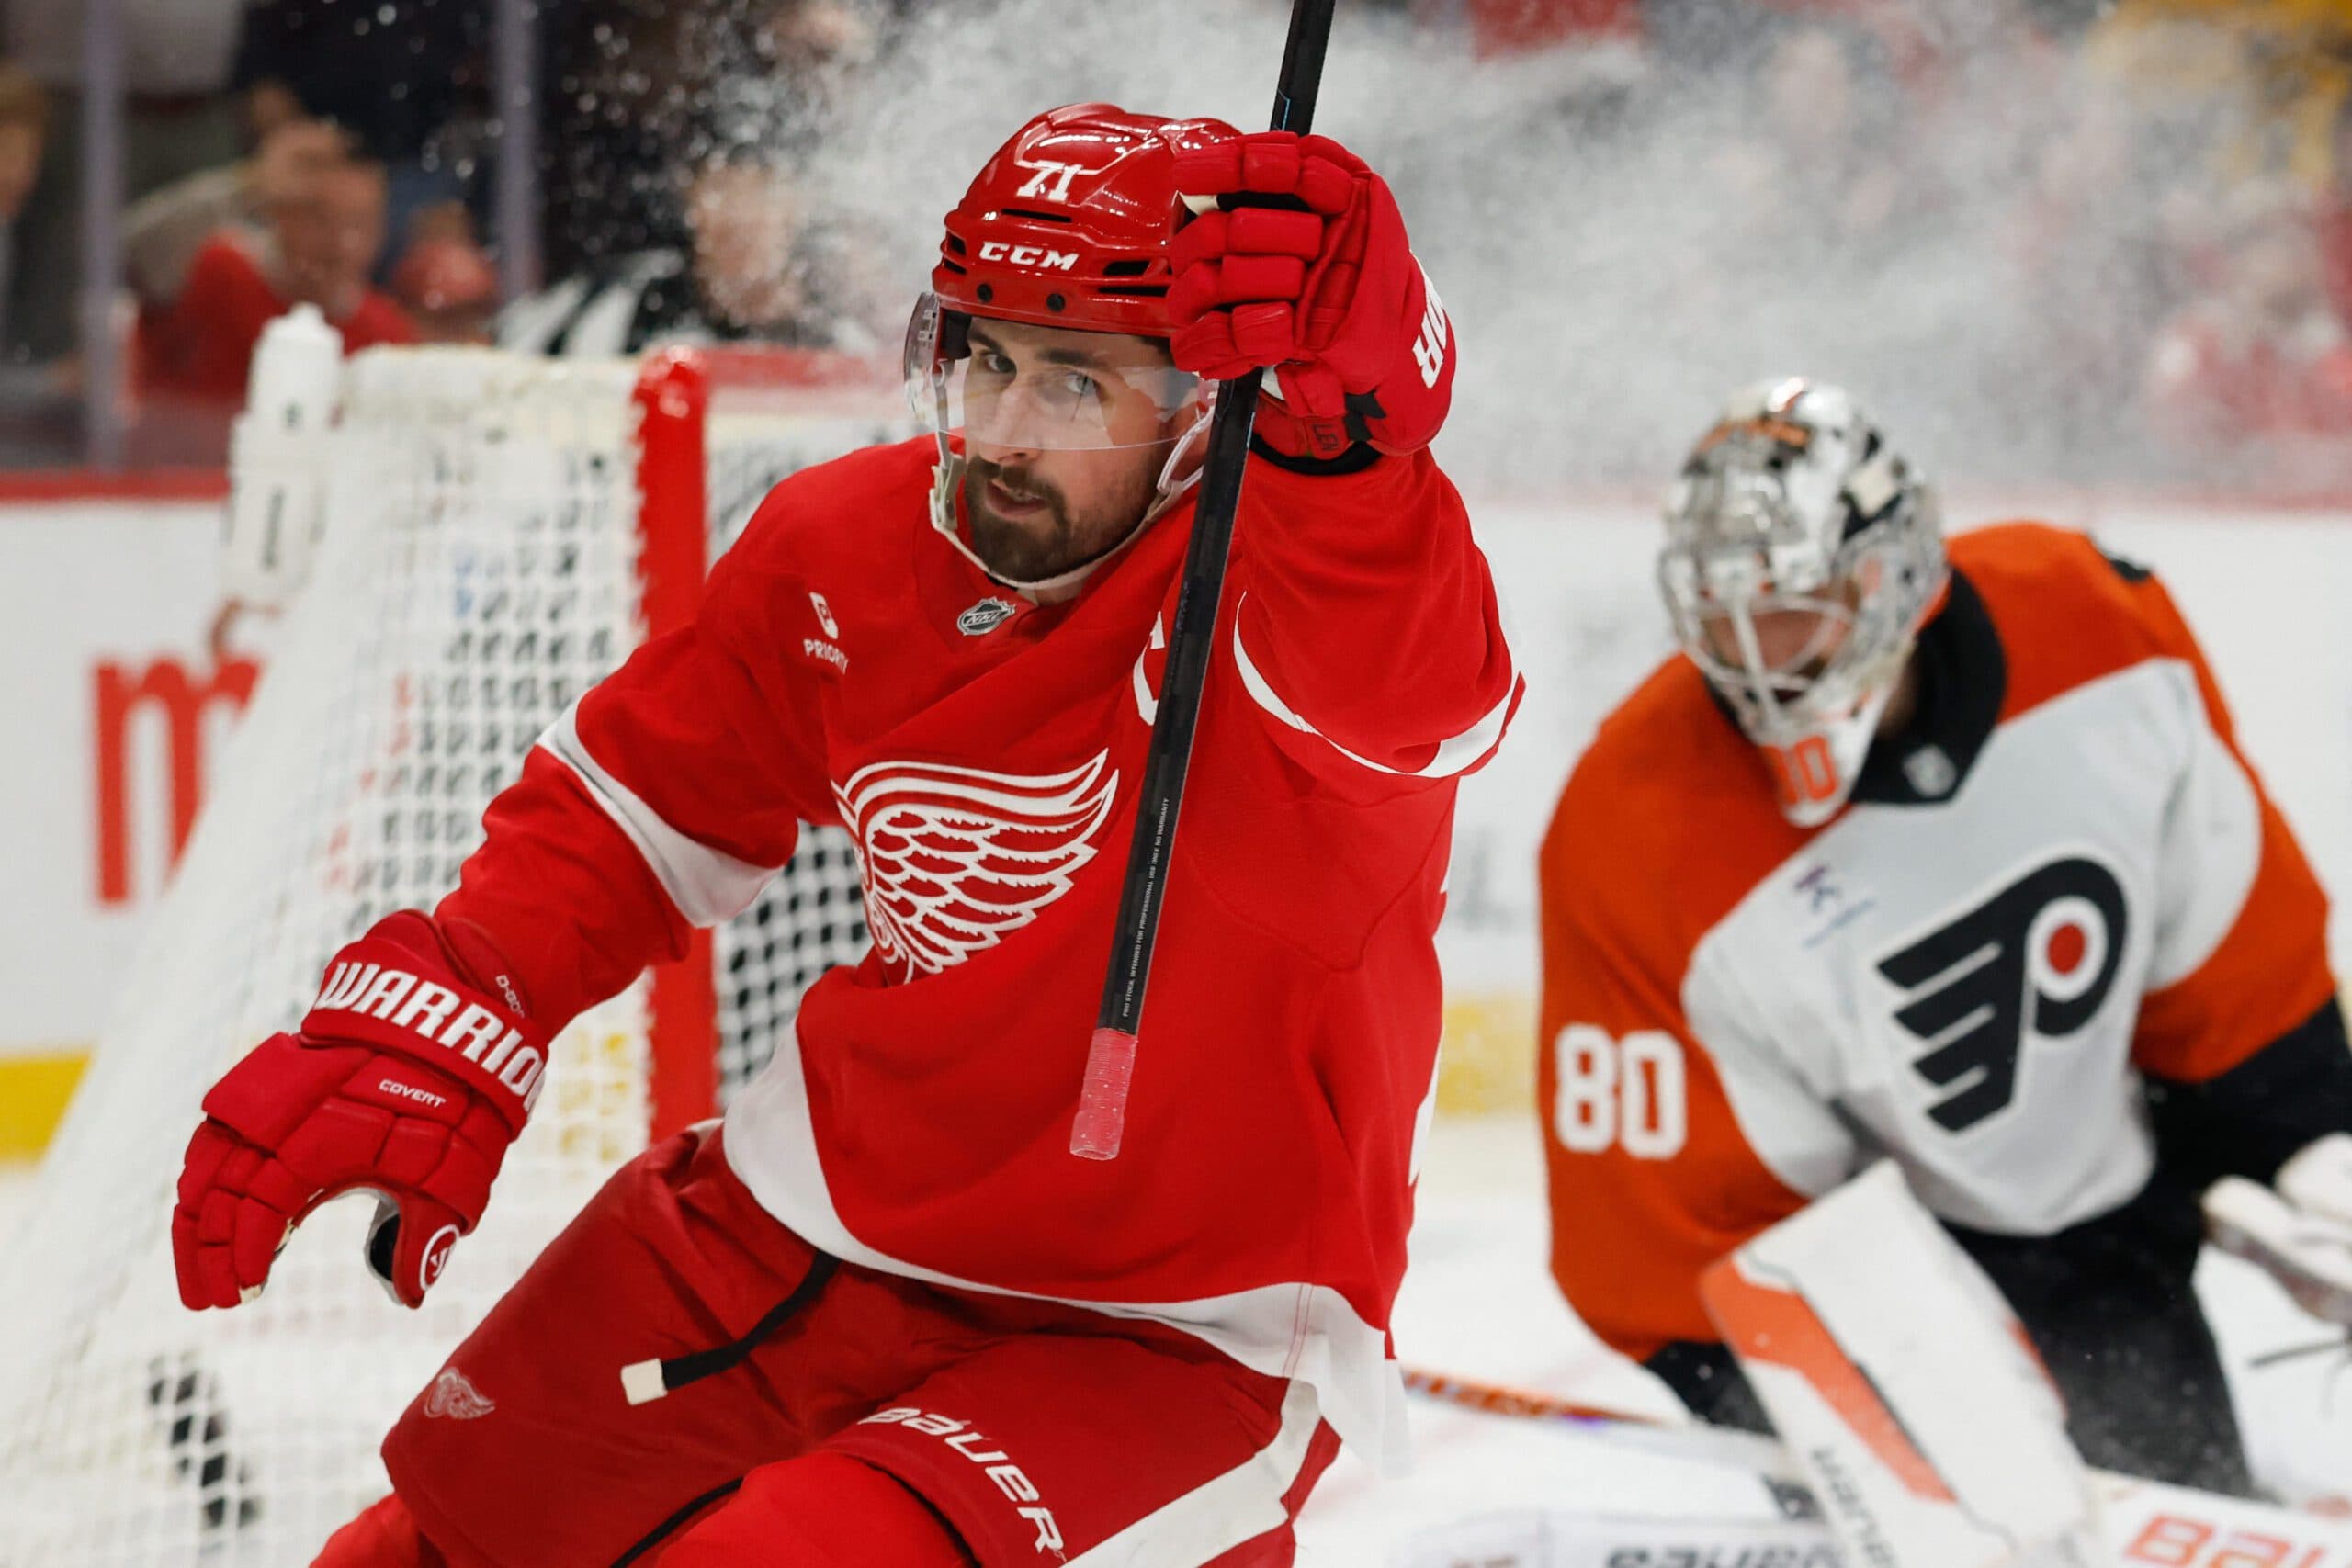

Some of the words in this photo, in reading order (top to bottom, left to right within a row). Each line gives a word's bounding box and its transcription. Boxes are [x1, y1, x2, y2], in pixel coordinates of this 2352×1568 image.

[1016, 160, 1083, 203] 71
[979, 241, 1080, 271] CCM
[1157, 797, 1170, 835] WARRANTY
[313, 962, 546, 1112] WARRIO
[378, 1078, 447, 1108] COVERT
[1555, 1022, 1686, 1162] 80
